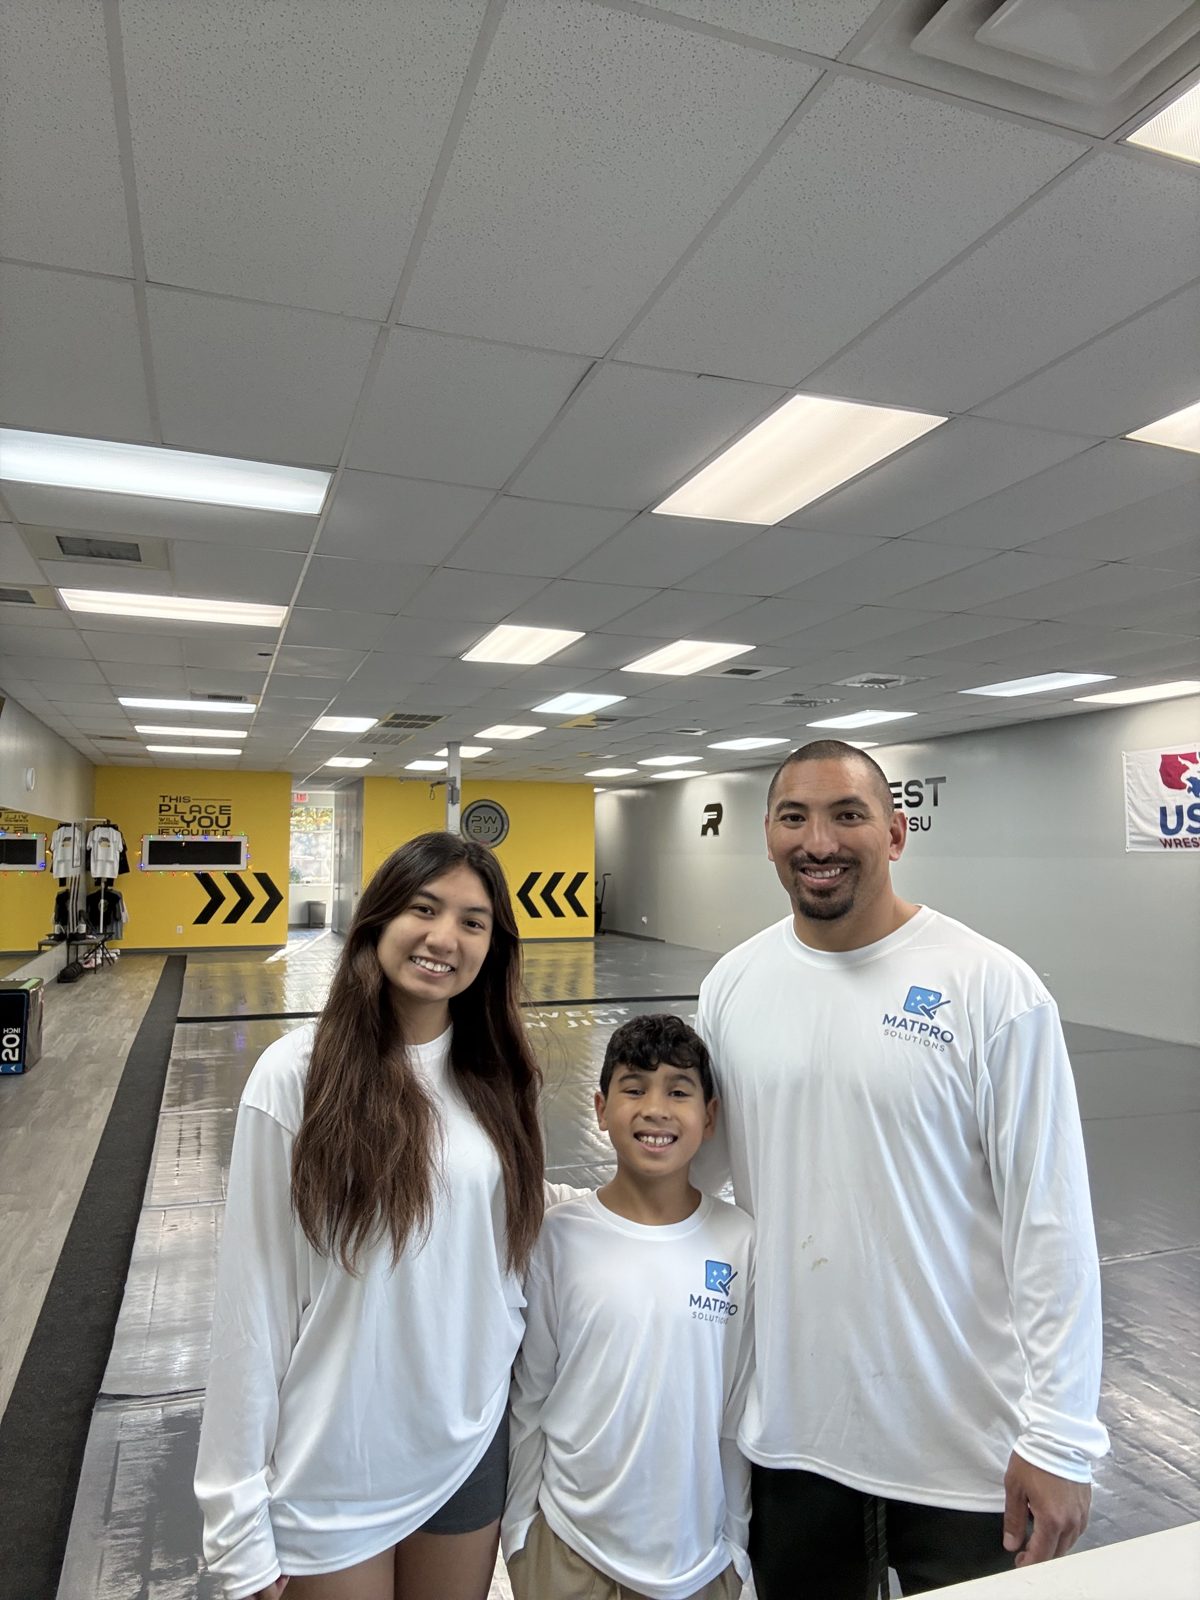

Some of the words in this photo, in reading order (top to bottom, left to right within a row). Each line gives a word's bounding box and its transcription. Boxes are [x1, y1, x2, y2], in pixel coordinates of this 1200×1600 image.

[159, 795, 191, 803] THIS
[158, 804, 231, 815] PLACE
[180, 815, 231, 828] YOU
[906, 816, 931, 832] SU
[1160, 837, 1200, 849] WRES
[882, 1014, 954, 1043] MATPRO
[883, 1029, 946, 1052] SOLUTIONS
[1, 1034, 20, 1062] 20
